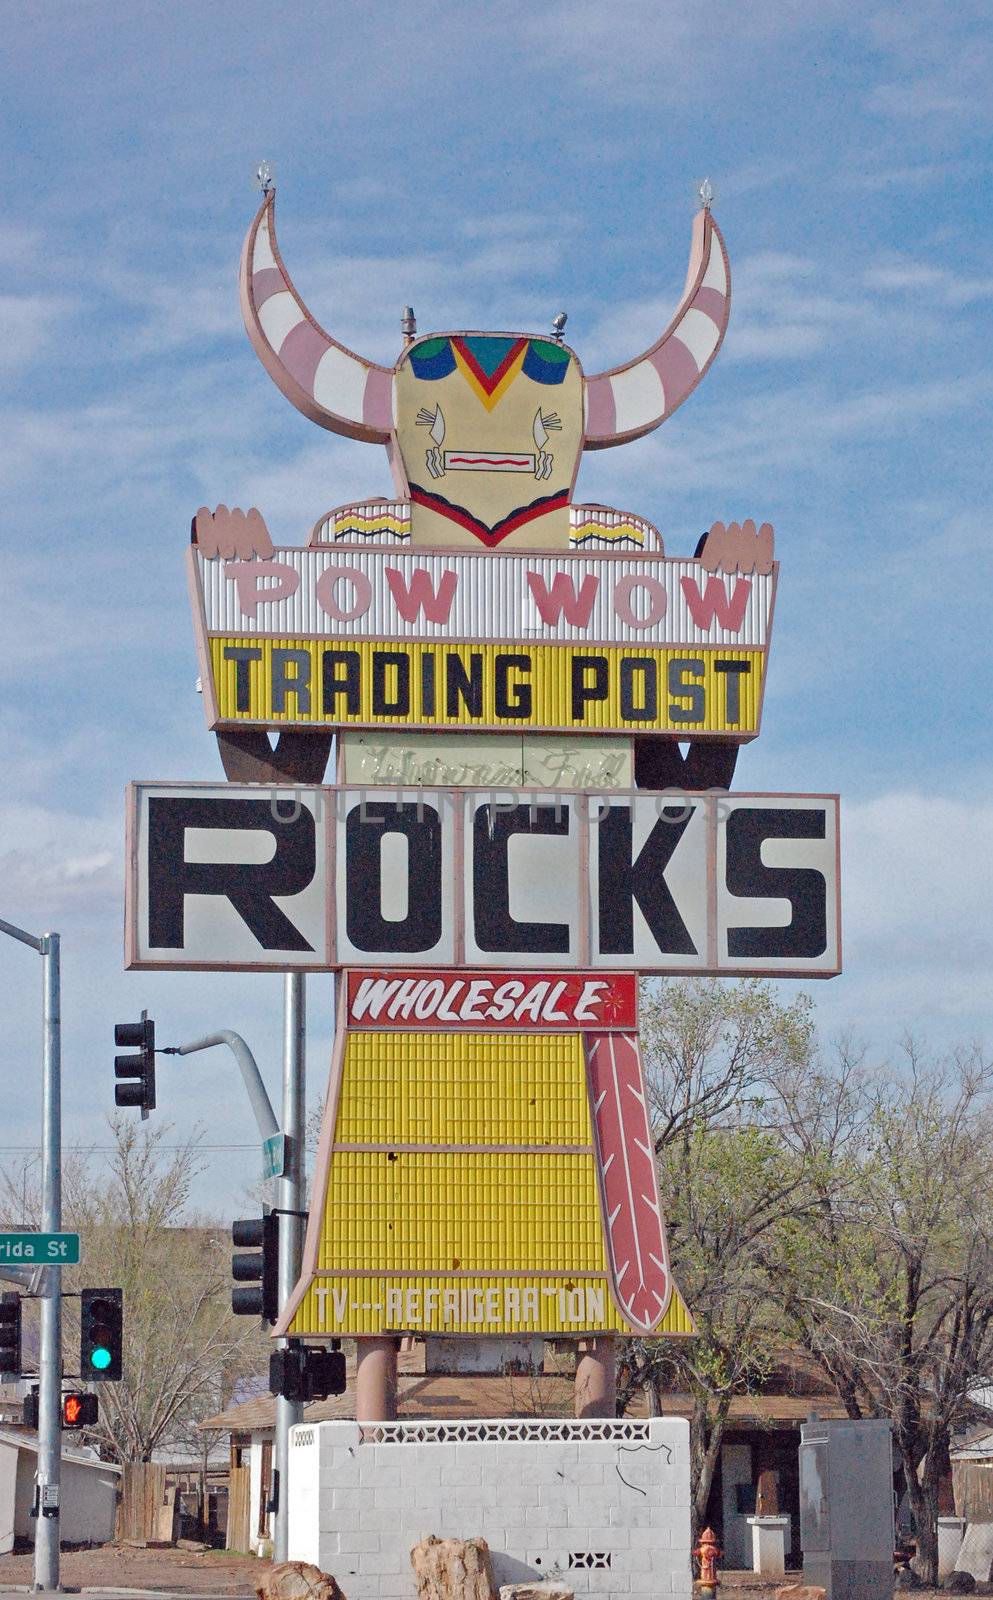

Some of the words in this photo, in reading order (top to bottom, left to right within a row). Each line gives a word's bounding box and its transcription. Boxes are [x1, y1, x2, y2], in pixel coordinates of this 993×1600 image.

[223, 560, 459, 626] POW
[526, 570, 753, 633] WOW
[223, 646, 533, 719] TRADING
[571, 655, 751, 724] POST
[148, 797, 828, 960] ROCKS
[351, 978, 609, 1023] WHOLESALE
[47, 1241, 68, 1257] St
